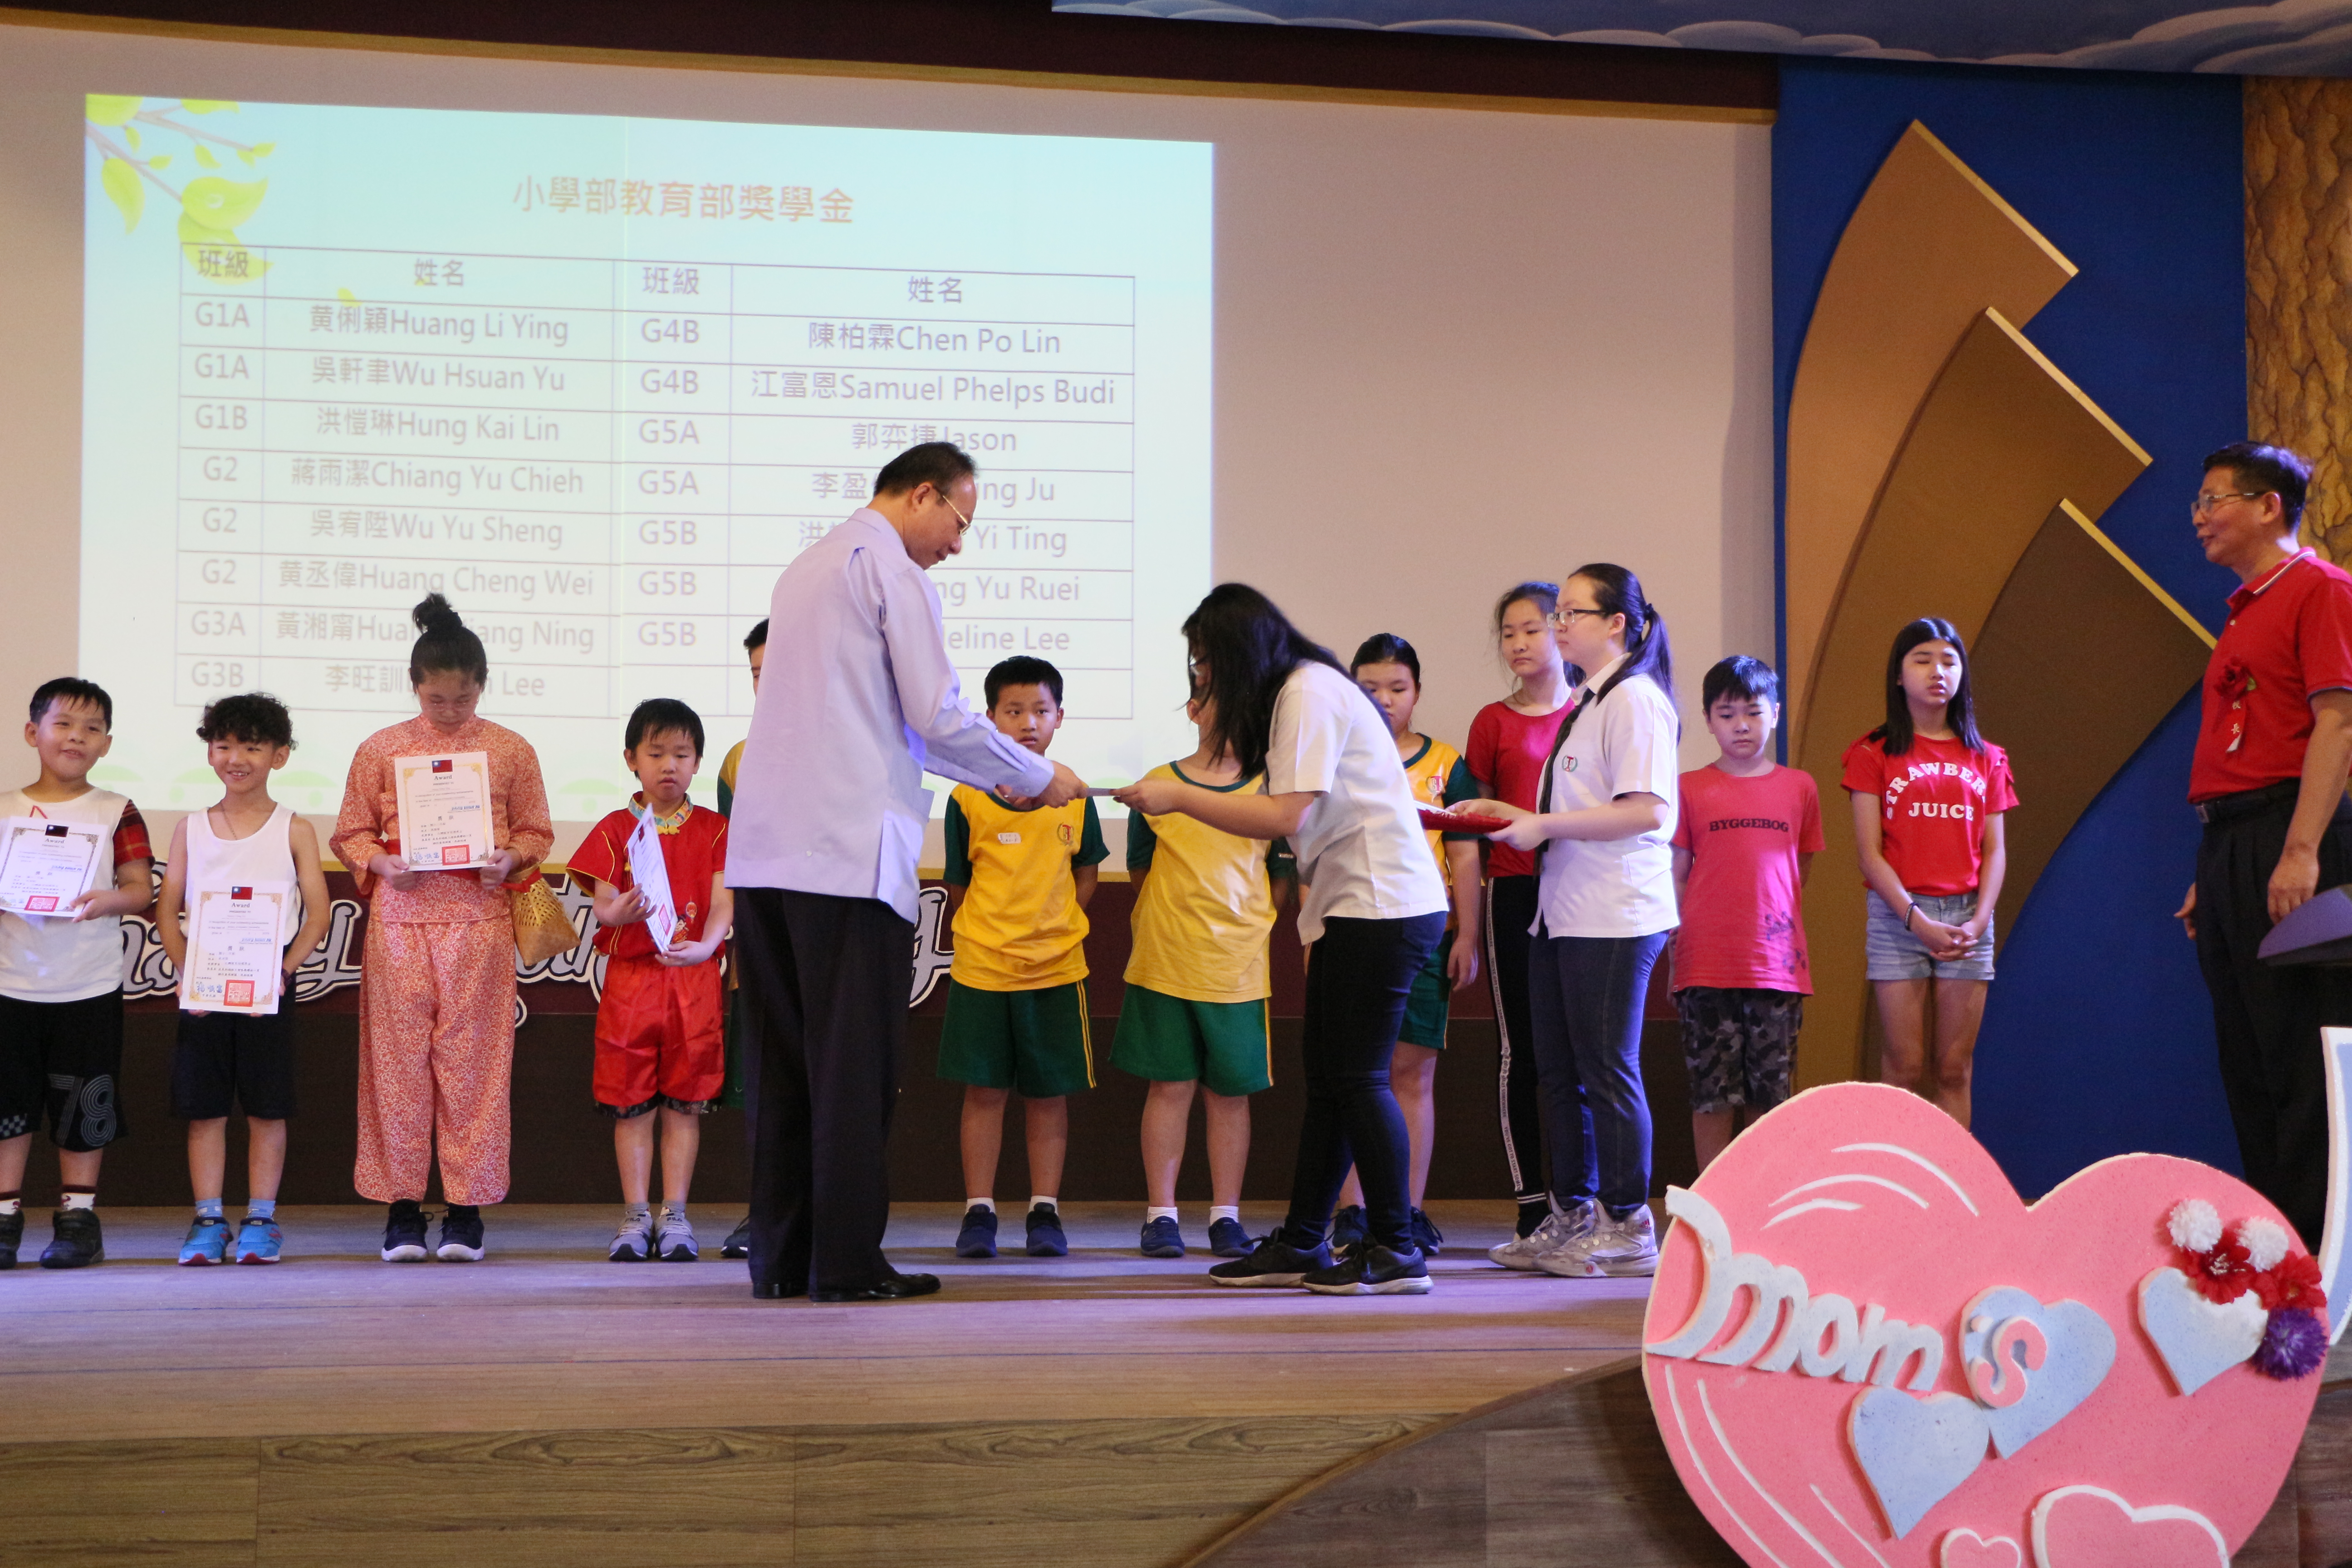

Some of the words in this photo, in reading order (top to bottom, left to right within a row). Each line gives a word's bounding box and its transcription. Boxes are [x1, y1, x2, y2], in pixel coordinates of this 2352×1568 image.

[513, 175, 854, 224] 小學部教育部獎學金
[198, 250, 249, 279] 班級
[414, 260, 464, 287] 姓名
[642, 266, 700, 296] 班級
[908, 277, 961, 303] 姓名
[196, 302, 249, 327] G1A
[485, 312, 503, 337] Li
[512, 313, 568, 347] Ying
[642, 318, 699, 343] G4B
[978, 328, 1011, 353] Po
[1022, 329, 1060, 353] Lin
[196, 353, 248, 379] G1A
[445, 363, 524, 389] Hsuan
[534, 366, 564, 391] Yu
[641, 369, 699, 394] G4B
[954, 376, 1044, 409] Phelps
[1055, 379, 1113, 404] Budi
[196, 404, 247, 430] G1B
[477, 415, 514, 439] Kai
[524, 416, 559, 441] Lin
[639, 419, 700, 444] G5A
[204, 456, 236, 482] G2
[470, 465, 501, 490] Yu
[510, 466, 582, 493] Chieh
[639, 470, 700, 495] G5A
[1026, 477, 1054, 501] Ju
[202, 507, 236, 533] G2
[442, 515, 473, 540] Yu
[483, 516, 562, 551] Sheng
[639, 520, 698, 545] G5B
[974, 525, 997, 549] Yi
[1007, 525, 1066, 558] Ting
[202, 559, 235, 584] G2
[454, 566, 535, 601] Cheng
[544, 570, 592, 595] Wei
[639, 571, 698, 596] G5B
[976, 576, 1010, 600] Yu
[1021, 576, 1078, 601] Ruei
[191, 610, 245, 636] G3A
[638, 622, 697, 647] G5B
[533, 621, 593, 653] Ning
[1024, 627, 1069, 650] Lee
[191, 661, 243, 688] G3B
[502, 671, 544, 696] Lee
[1908, 802, 1974, 822] JUICE
[1709, 818, 1789, 833] BYGGEBOG
